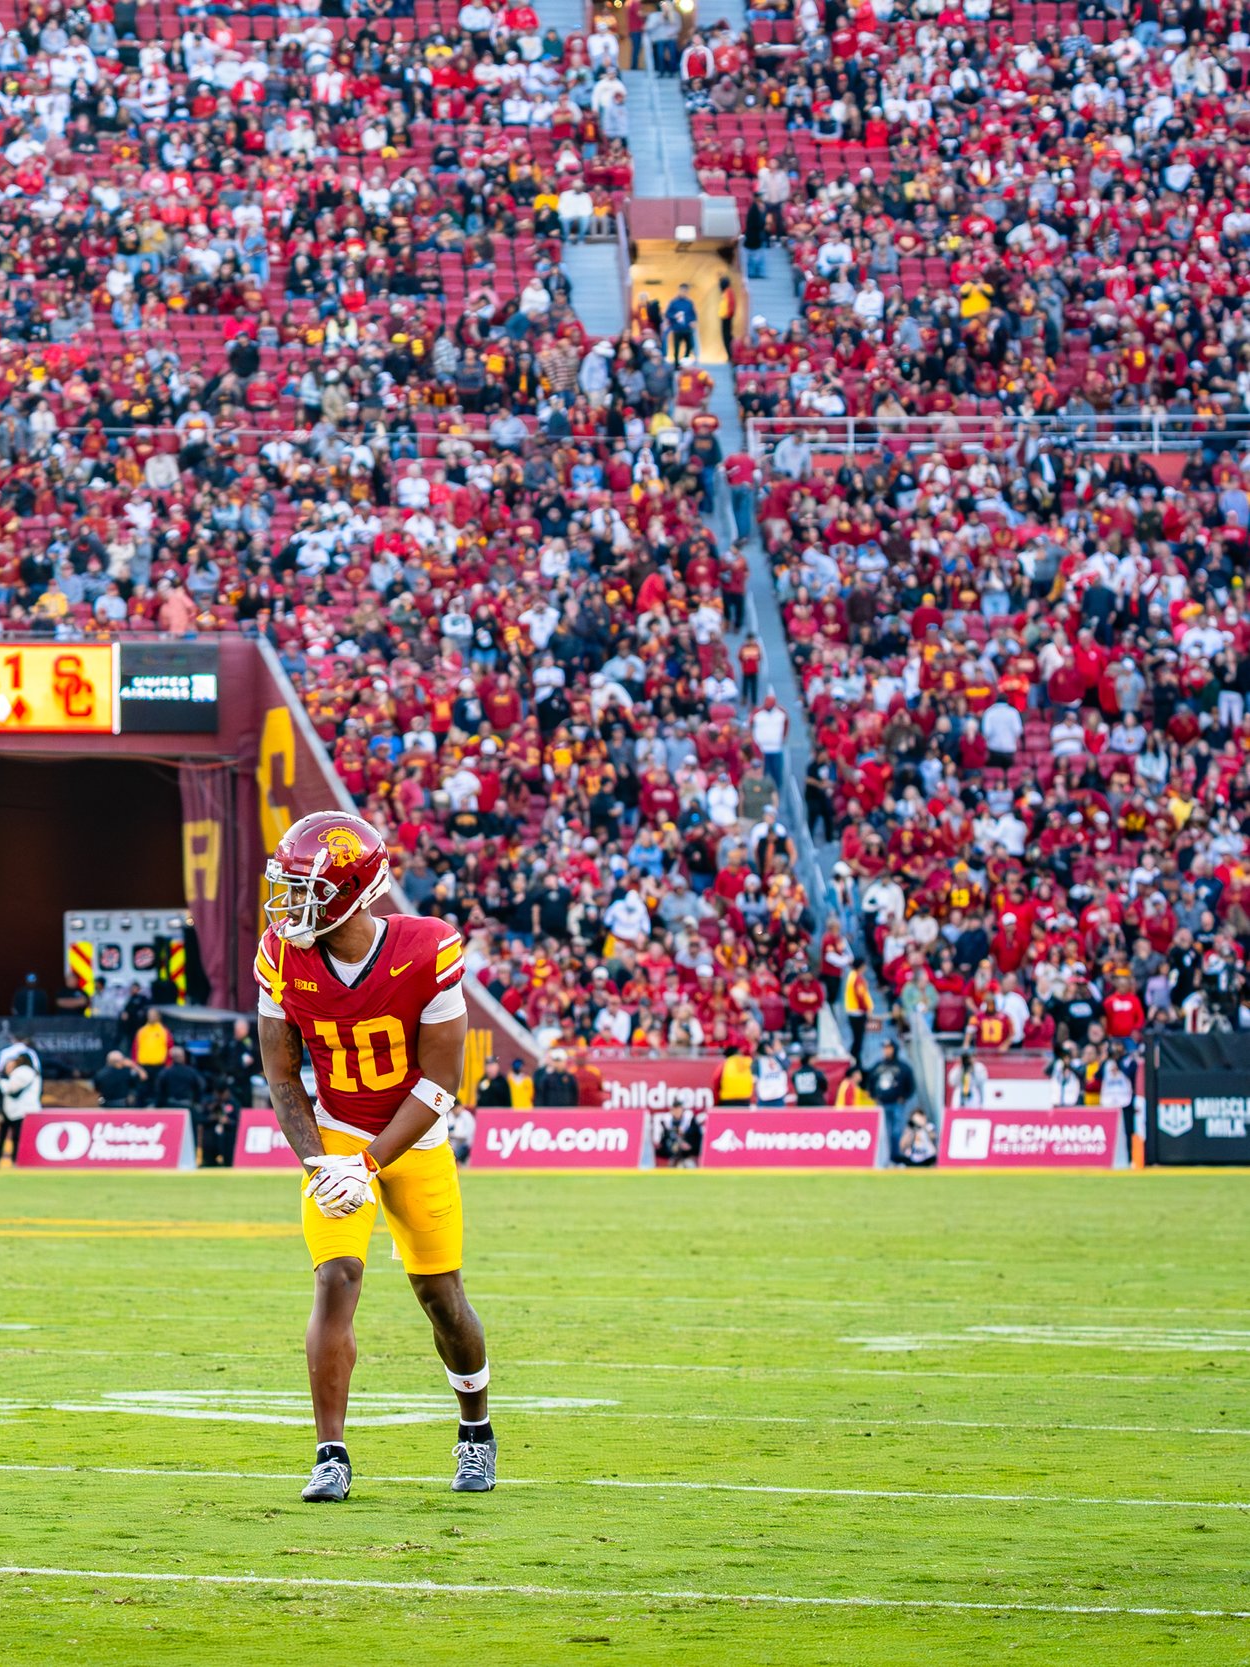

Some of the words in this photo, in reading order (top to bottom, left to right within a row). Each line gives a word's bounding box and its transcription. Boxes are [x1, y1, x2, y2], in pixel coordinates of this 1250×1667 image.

[313, 1014, 408, 1093] 10
[92, 1121, 166, 1143] United
[993, 1124, 1107, 1143] PECHANGA
[1205, 1118, 1247, 1138] MILK
[486, 1121, 628, 1159] Lyfe.com
[745, 1129, 825, 1150] Invesco
[1051, 1142, 1107, 1155] CASINO
[88, 1140, 167, 1161] Rentals
